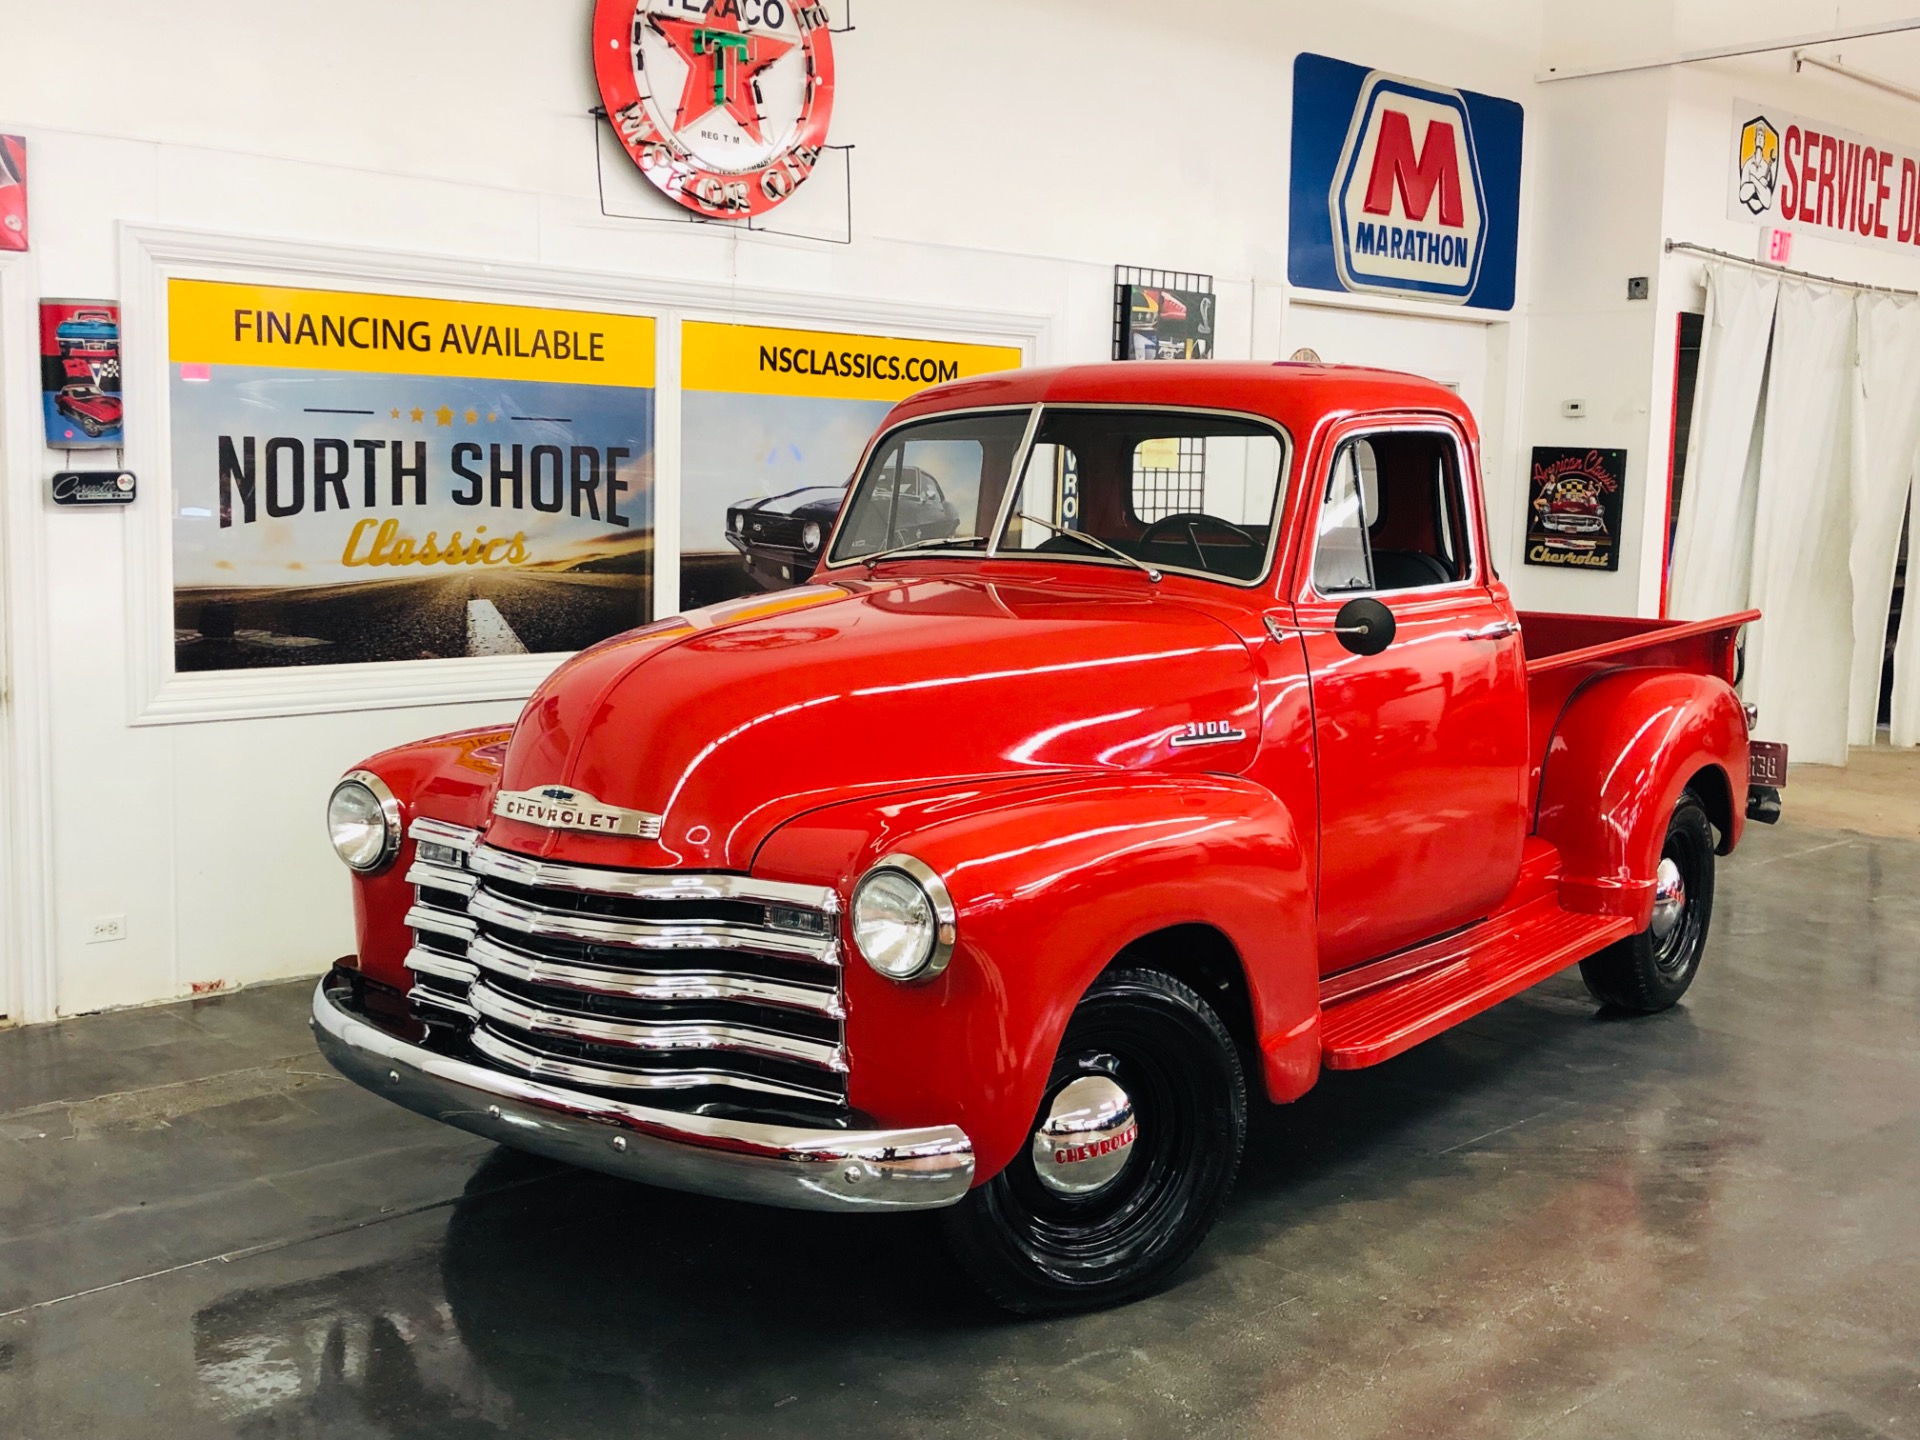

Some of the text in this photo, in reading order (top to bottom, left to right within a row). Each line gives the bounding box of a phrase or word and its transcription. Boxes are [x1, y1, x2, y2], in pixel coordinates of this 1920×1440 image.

[701, 130, 740, 145] REG T M
[1363, 109, 1464, 228] M
[1781, 125, 1893, 239] SERVICE
[1355, 222, 1468, 268] MARATHON
[233, 308, 605, 362] FINANCING AVAILABLE
[758, 345, 959, 384] NSCLASSICS.COM
[218, 435, 630, 529] NORTH SHORE
[341, 517, 532, 568] Classics
[1529, 545, 1609, 567] Chevrolet
[1185, 720, 1230, 737] 3100
[506, 801, 620, 830] CHEVROLET
[1054, 1123, 1139, 1165] CHEVROLET
